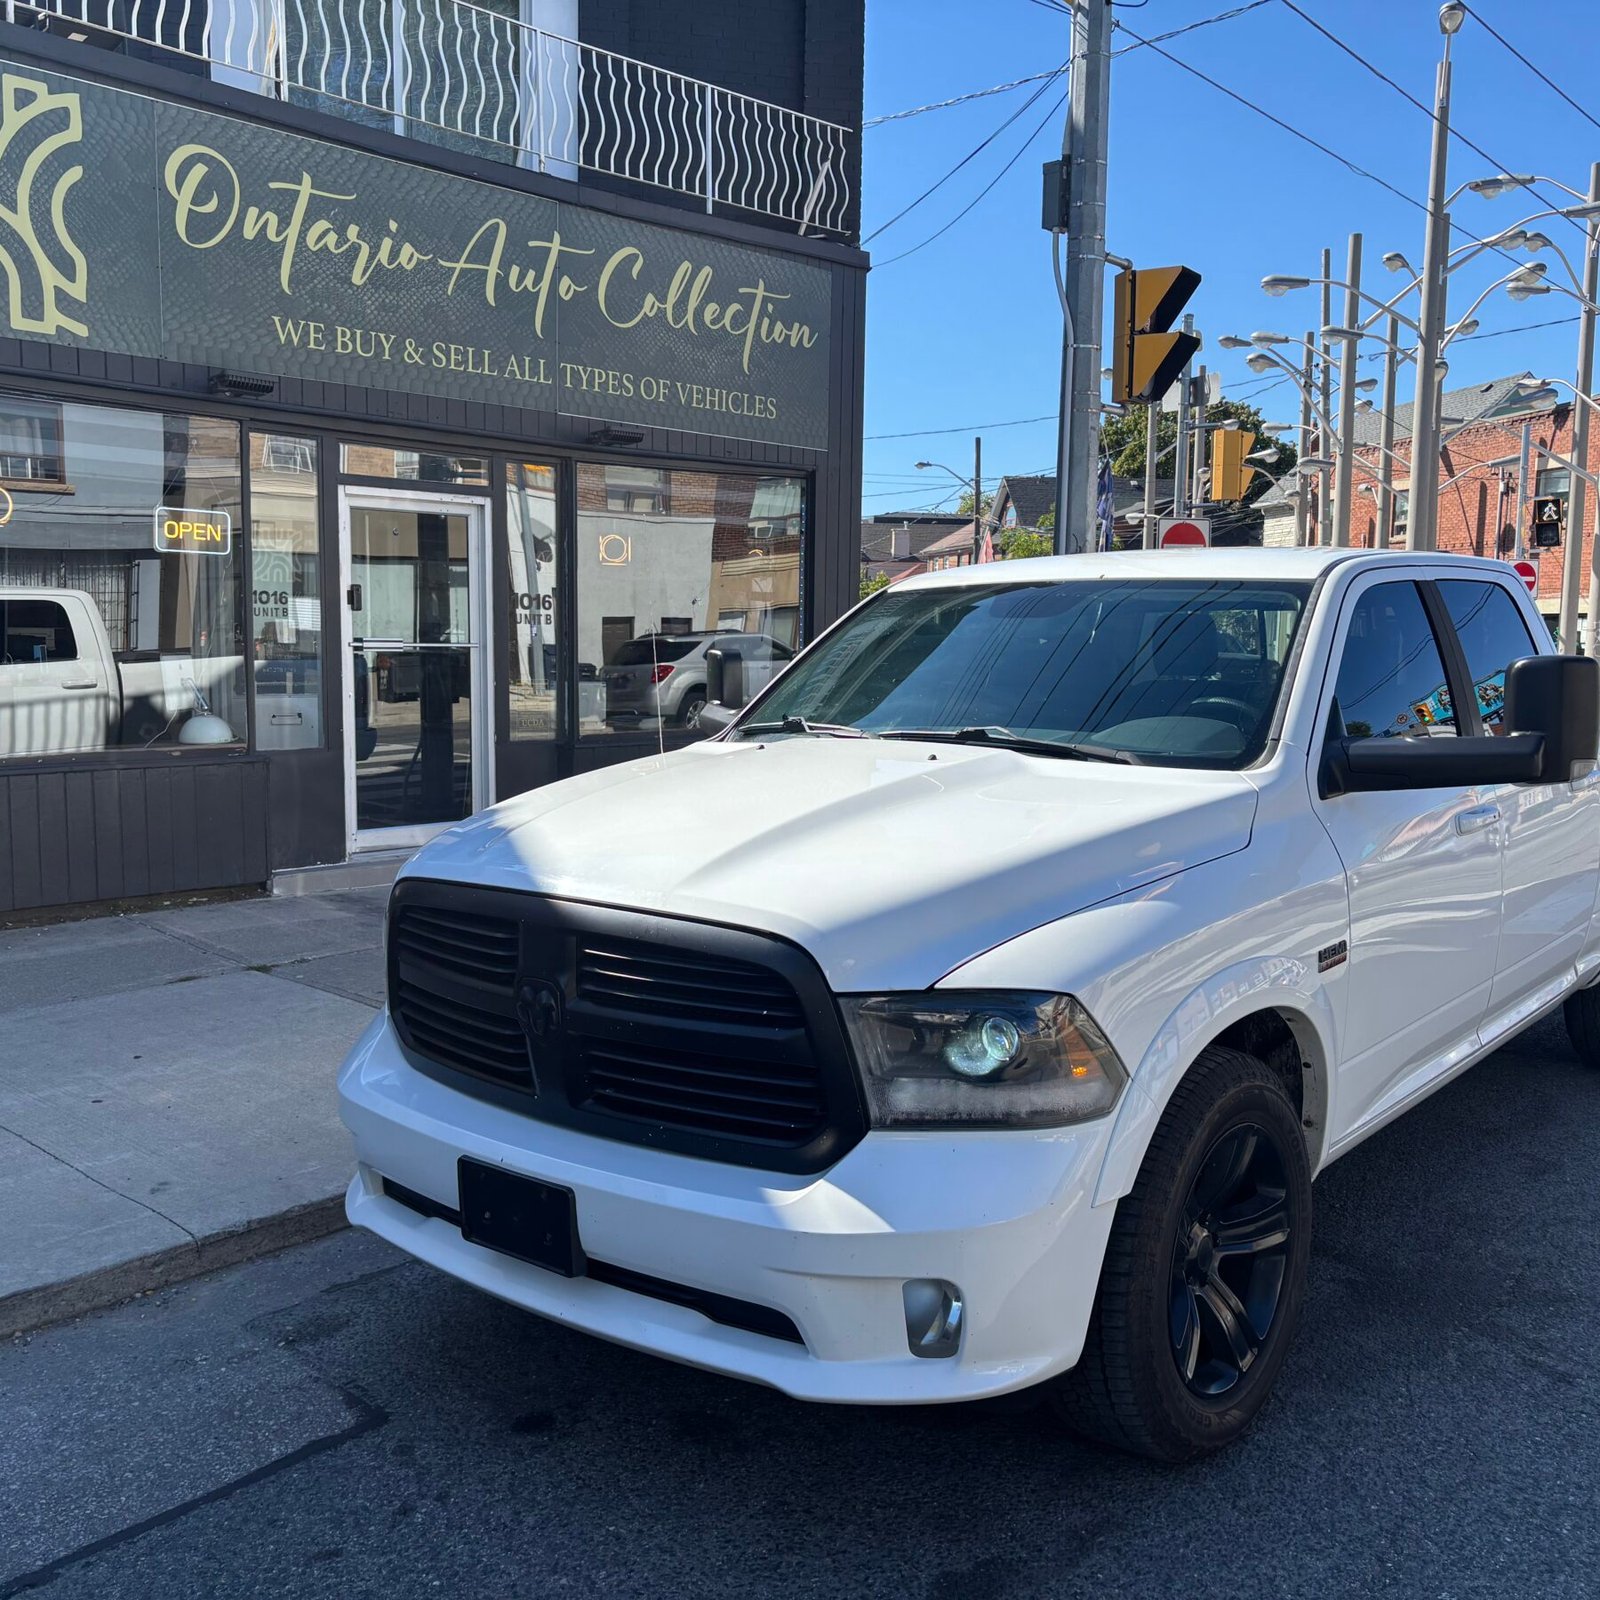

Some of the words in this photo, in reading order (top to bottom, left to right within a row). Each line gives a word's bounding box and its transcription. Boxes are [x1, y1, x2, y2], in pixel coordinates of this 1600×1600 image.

[164, 143, 432, 295] Ontario
[438, 218, 595, 338] Auto
[598, 246, 819, 374] Collection
[271, 315, 327, 351] WE
[335, 325, 397, 361] BUY
[403, 337, 426, 366] &
[432, 341, 498, 376] SELL
[503, 355, 553, 385] ALL
[560, 361, 634, 398] TYPES
[640, 375, 671, 402] OF
[676, 381, 777, 420] VEHICLES
[163, 520, 221, 542] OPEN
[252, 589, 289, 605] 1016
[511, 592, 553, 610] 1016
[253, 607, 280, 617] UNIT
[282, 607, 289, 617] B
[514, 613, 542, 625] UNIT
[545, 613, 552, 625] B
